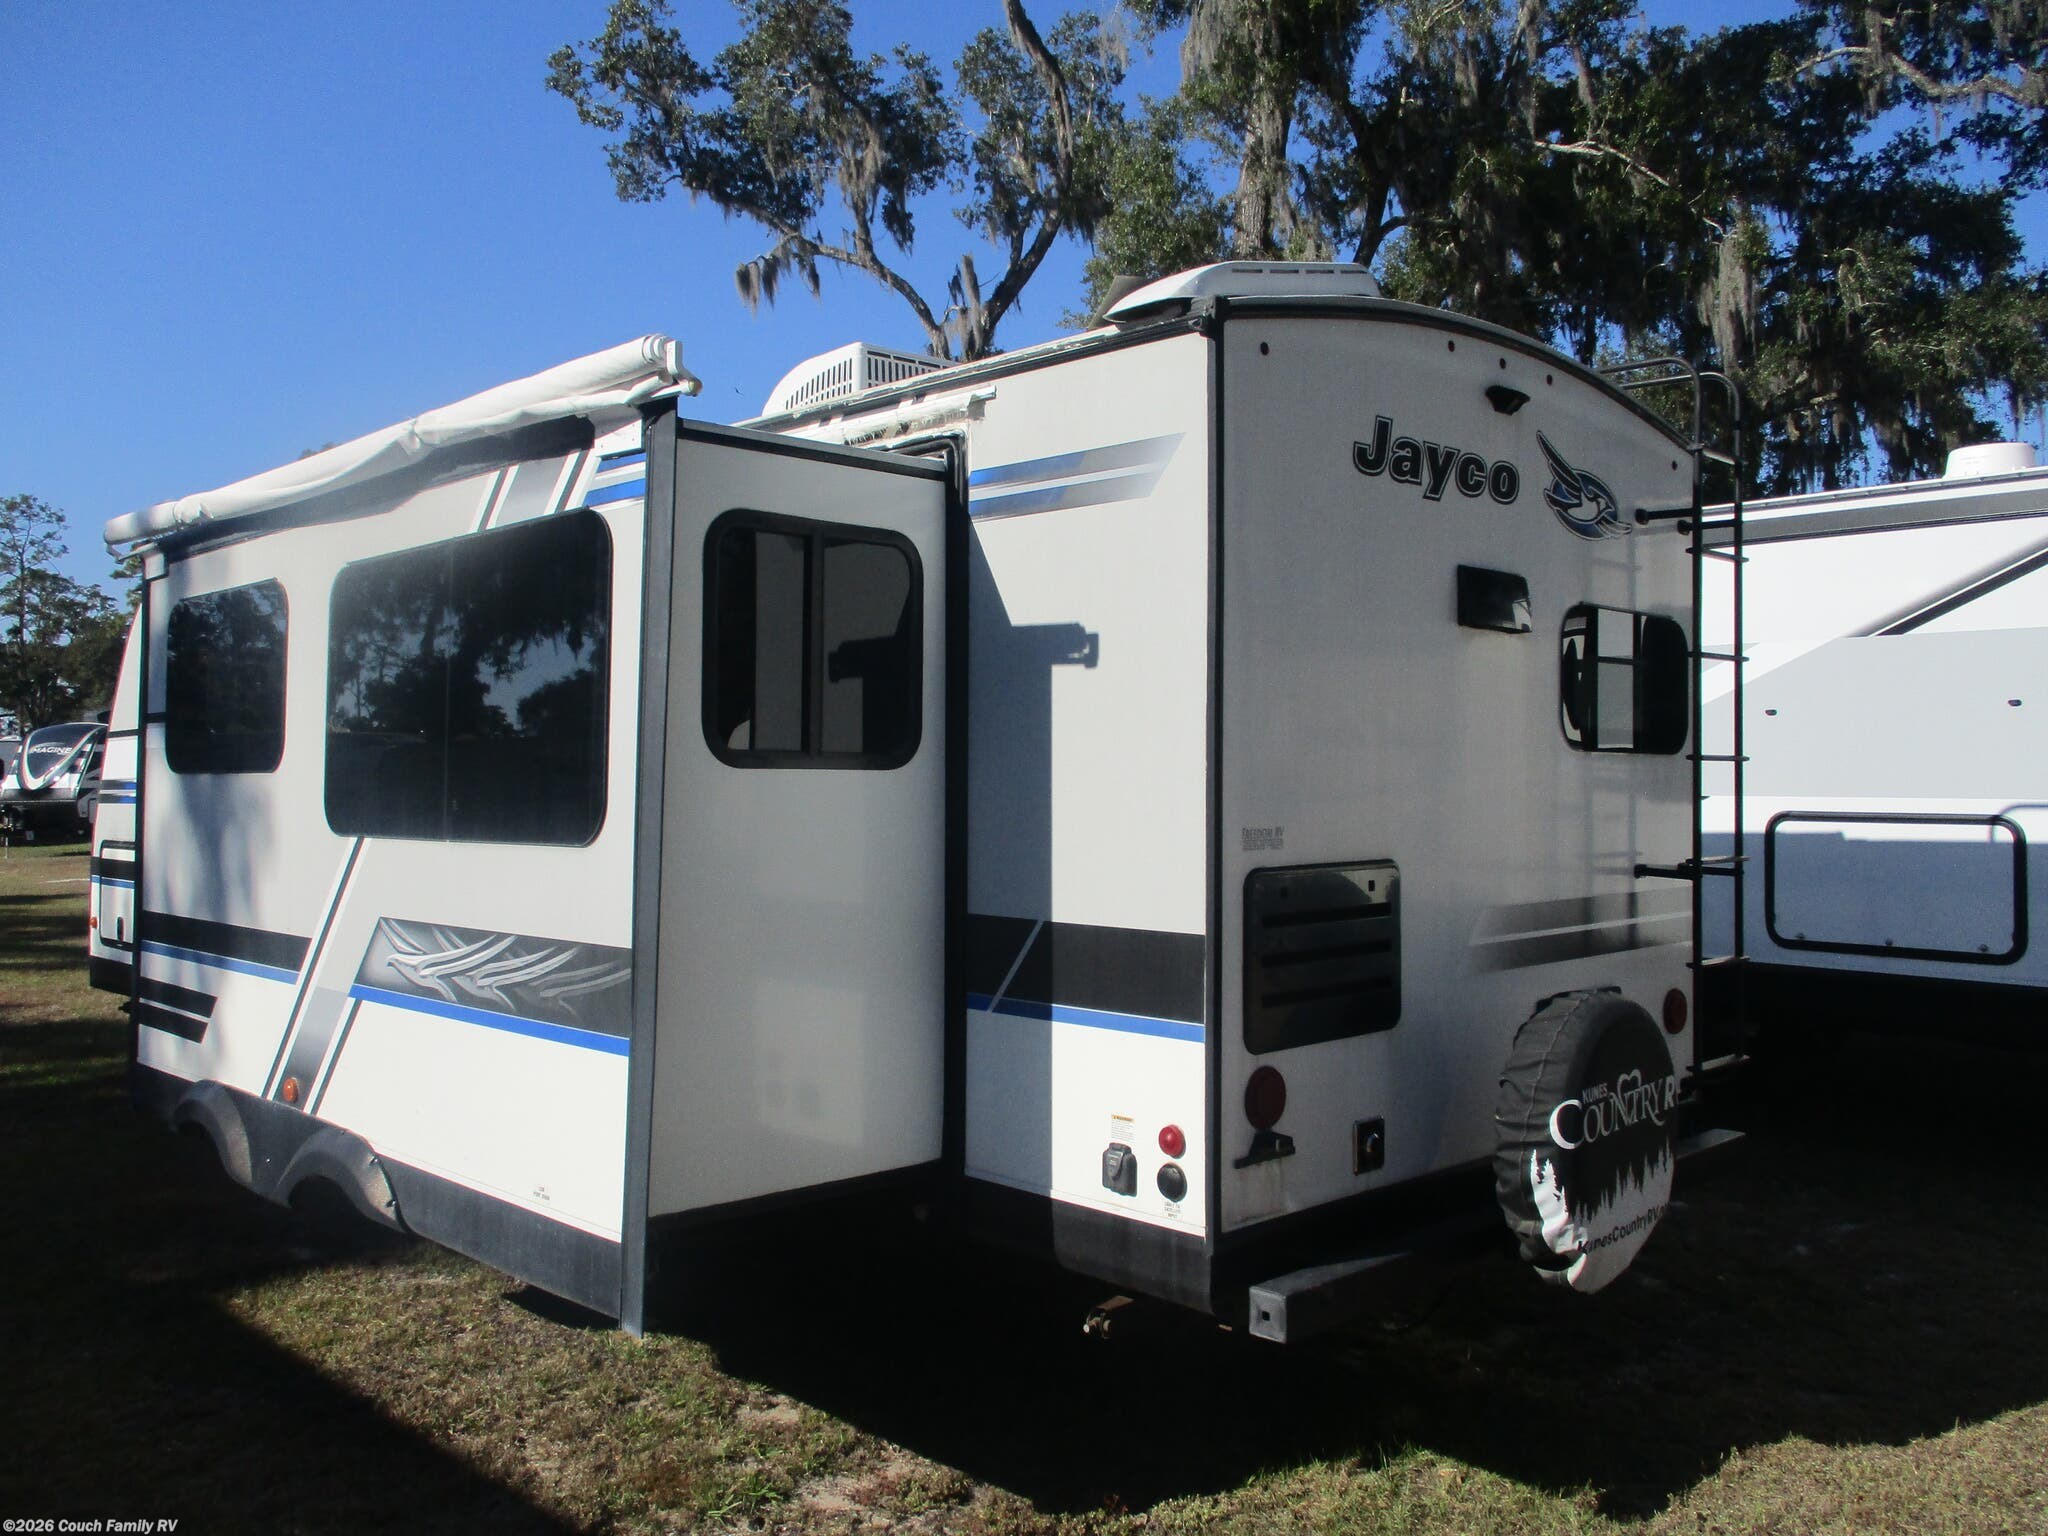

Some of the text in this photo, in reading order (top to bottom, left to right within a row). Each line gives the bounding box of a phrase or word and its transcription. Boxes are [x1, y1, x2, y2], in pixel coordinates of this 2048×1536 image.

[1353, 415, 1520, 504] Jayco
[1549, 1069, 1665, 1150] COUNTRY
[1582, 1082, 1608, 1103] KUNES
